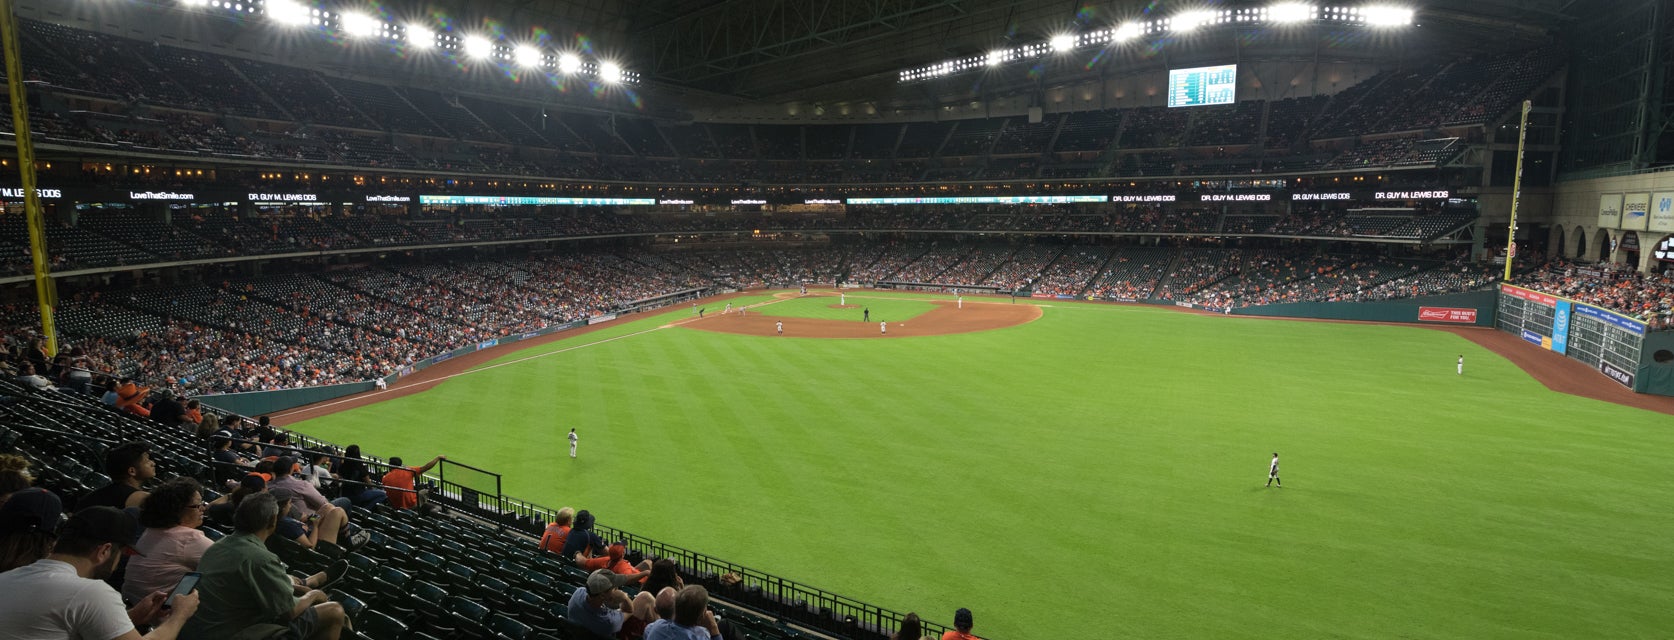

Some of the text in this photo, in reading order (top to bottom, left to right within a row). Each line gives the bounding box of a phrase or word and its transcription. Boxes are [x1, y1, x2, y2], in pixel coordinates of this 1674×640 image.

[14, 188, 42, 198] LES
[130, 191, 194, 200] LoveThatSmile.com
[1410, 191, 1432, 199] LEWIS
